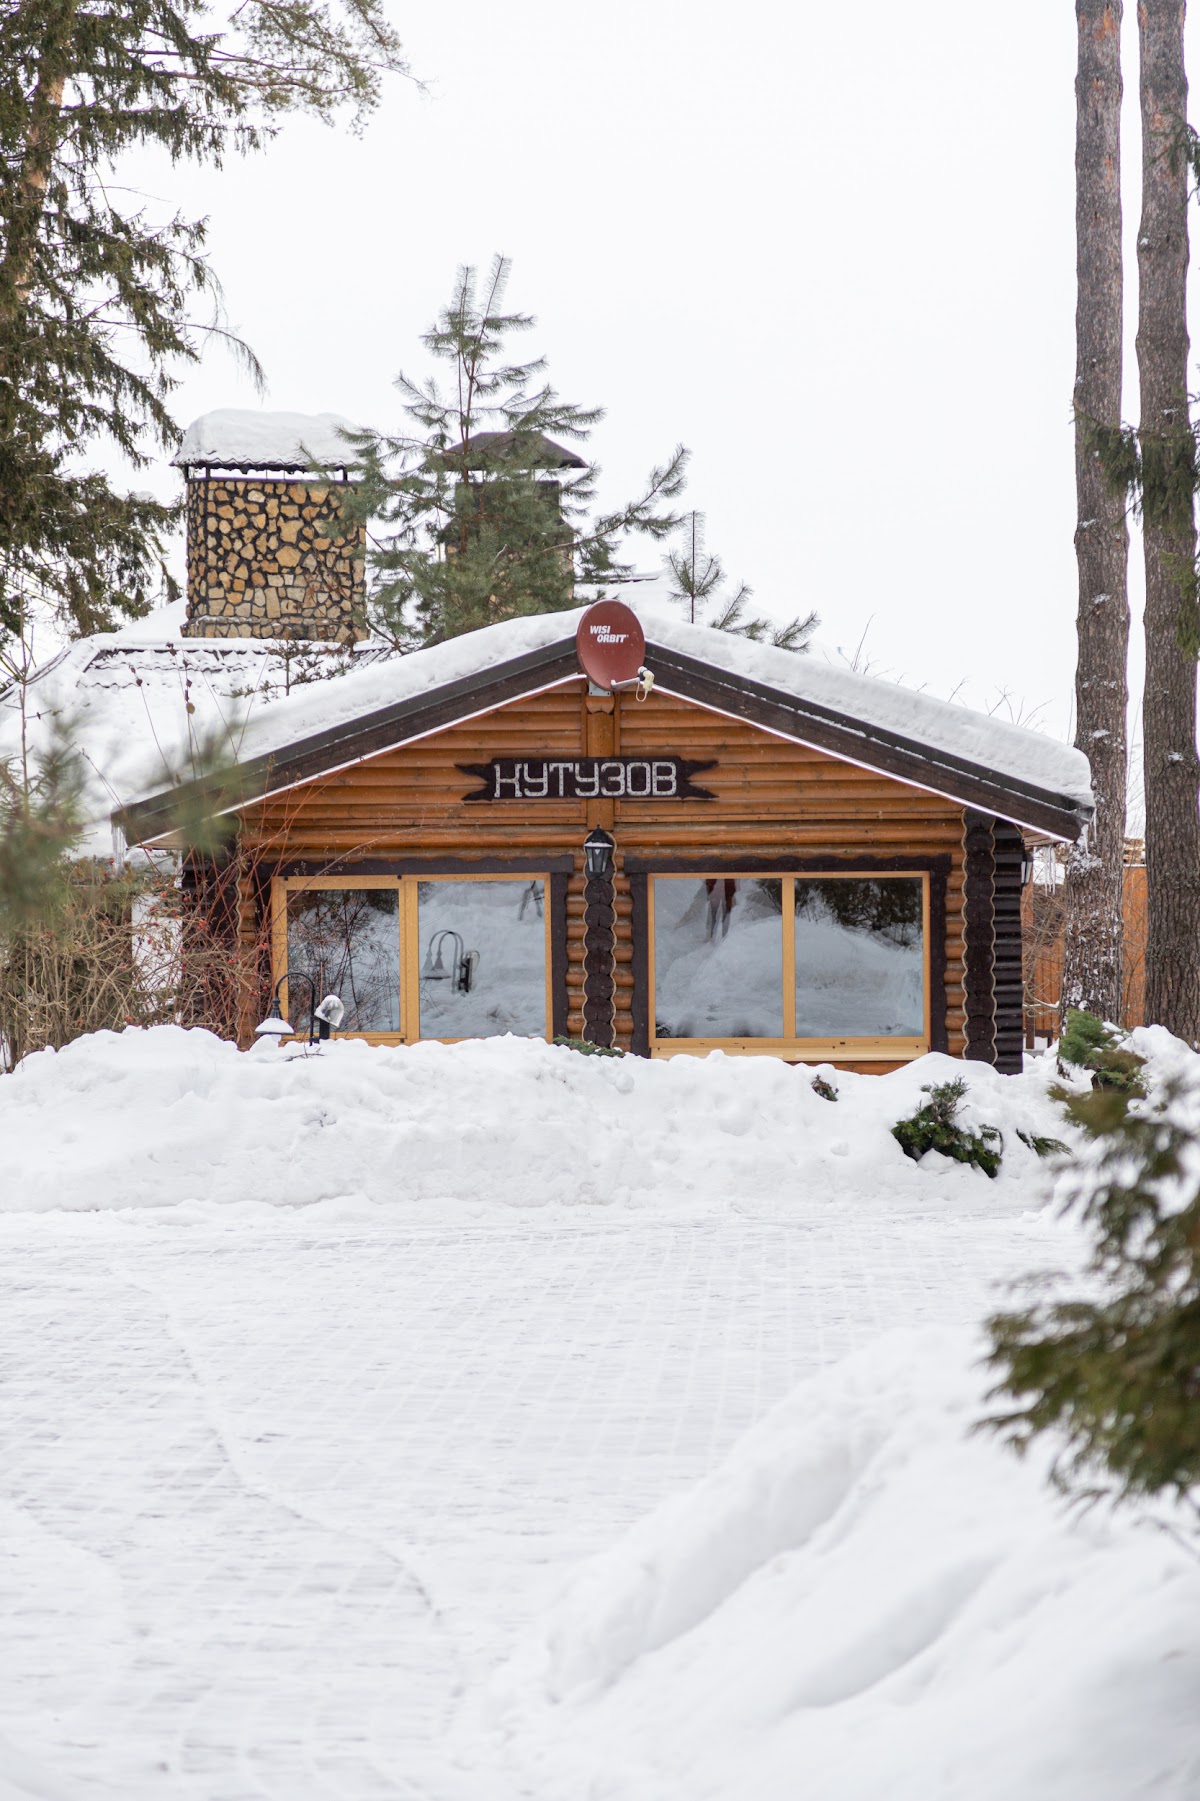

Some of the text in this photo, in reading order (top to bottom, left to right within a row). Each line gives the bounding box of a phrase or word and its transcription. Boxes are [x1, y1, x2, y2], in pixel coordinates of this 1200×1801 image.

[590, 625, 611, 634] WISI
[597, 634, 627, 643] ORBIT
[493, 762, 677, 798] КУТУЗОВ
